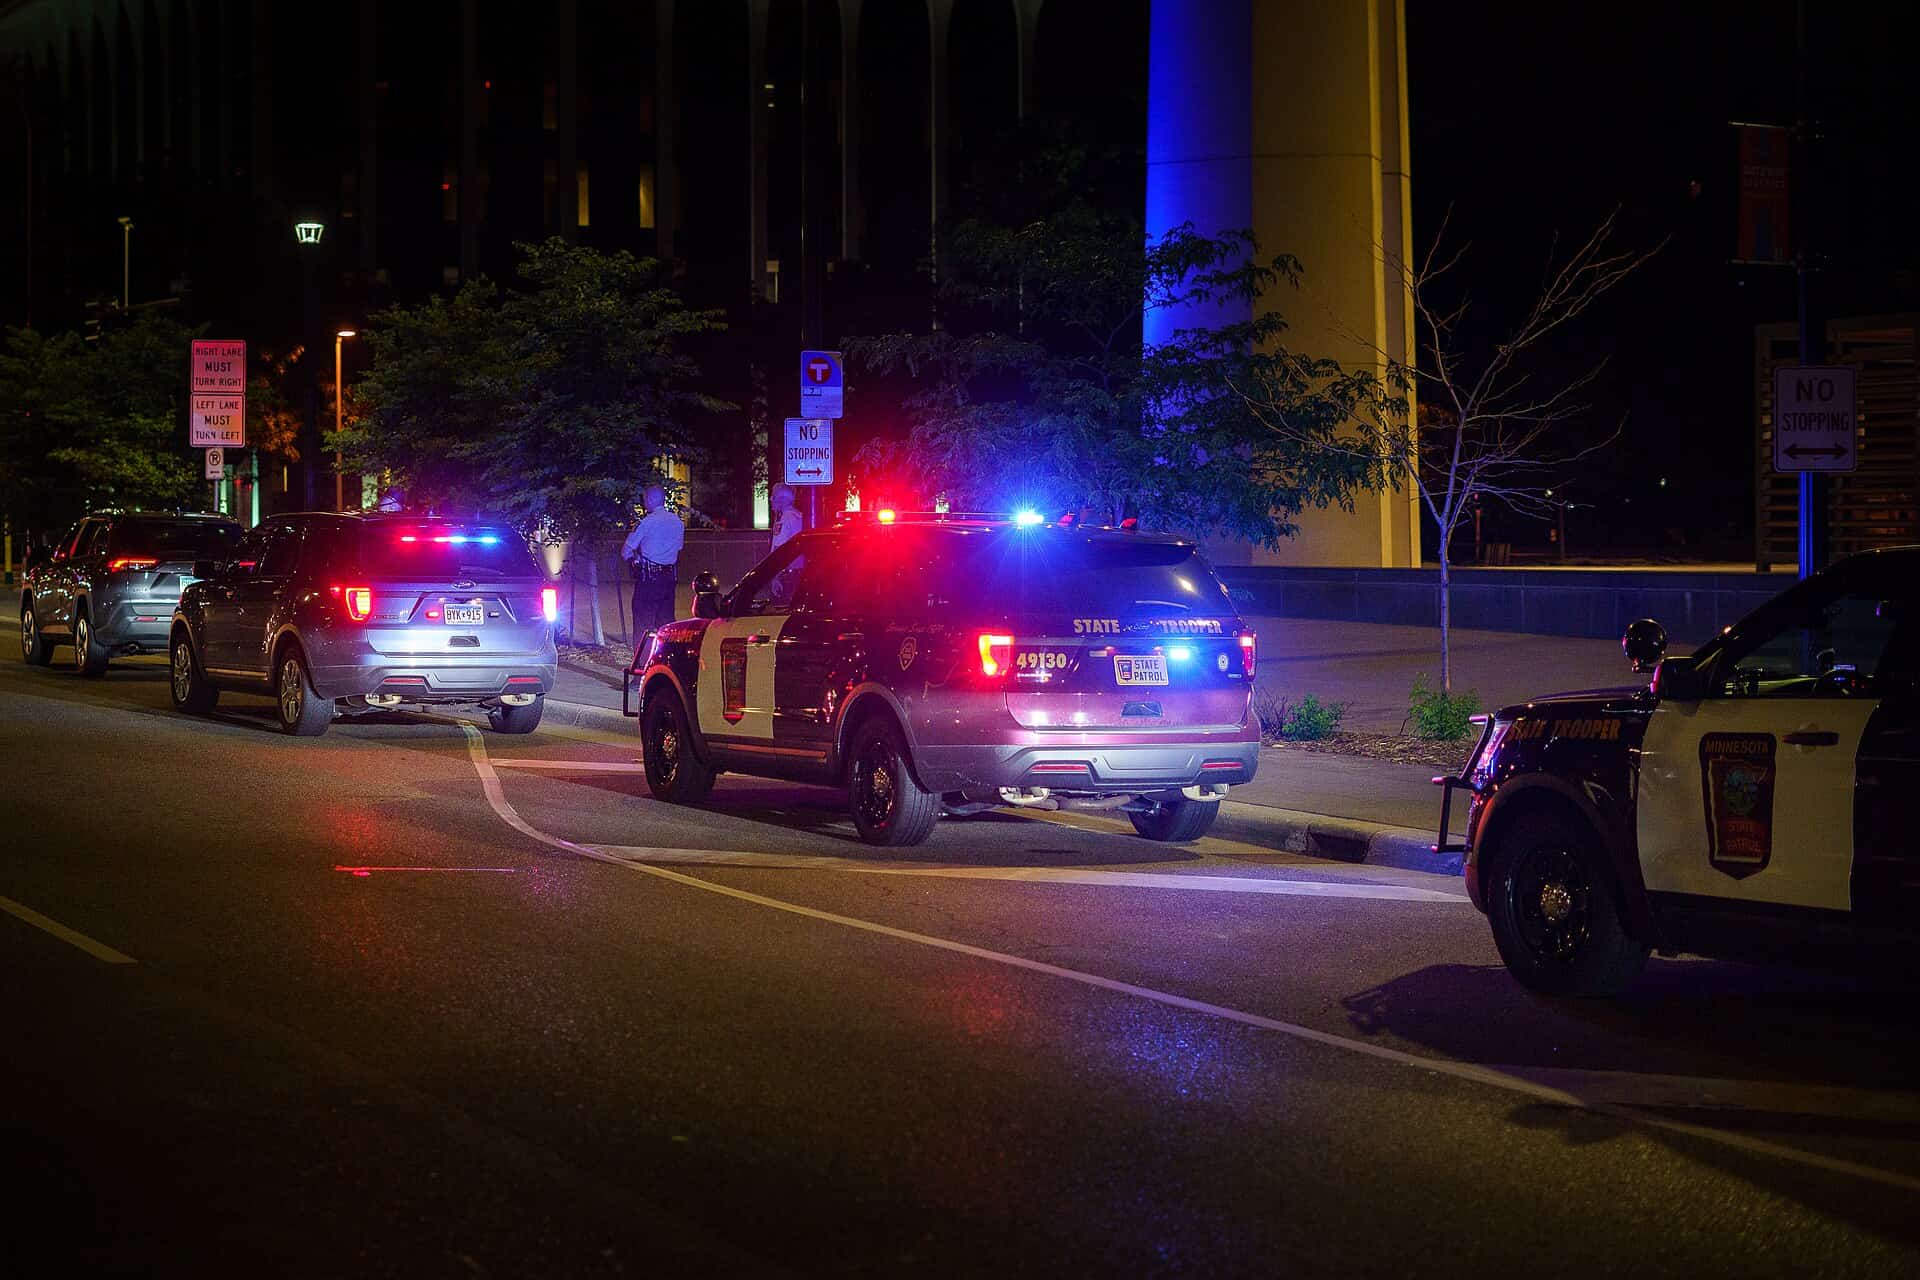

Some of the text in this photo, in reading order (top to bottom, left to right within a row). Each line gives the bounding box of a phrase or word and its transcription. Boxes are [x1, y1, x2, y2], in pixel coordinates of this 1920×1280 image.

[195, 347, 242, 357] RIGHT LANE
[205, 361, 232, 372] MUST
[195, 377, 242, 387] TURN RIGHT
[1796, 379, 1835, 402] NO
[196, 400, 240, 410] LEFT LANE
[204, 415, 231, 426] MUST
[1783, 412, 1849, 433] STOPPING
[195, 431, 240, 441] TURN LEFT
[800, 425, 819, 441] NO
[788, 447, 830, 460] STOPPING
[1073, 618, 1121, 634] STATE
[1160, 618, 1224, 635] TROOPER
[1016, 652, 1067, 669] 49130
[1134, 659, 1160, 670] STATE
[1134, 671, 1166, 682] PATROL
[1549, 719, 1622, 741] TROOPER
[1704, 739, 1769, 753] MINNESOTA
